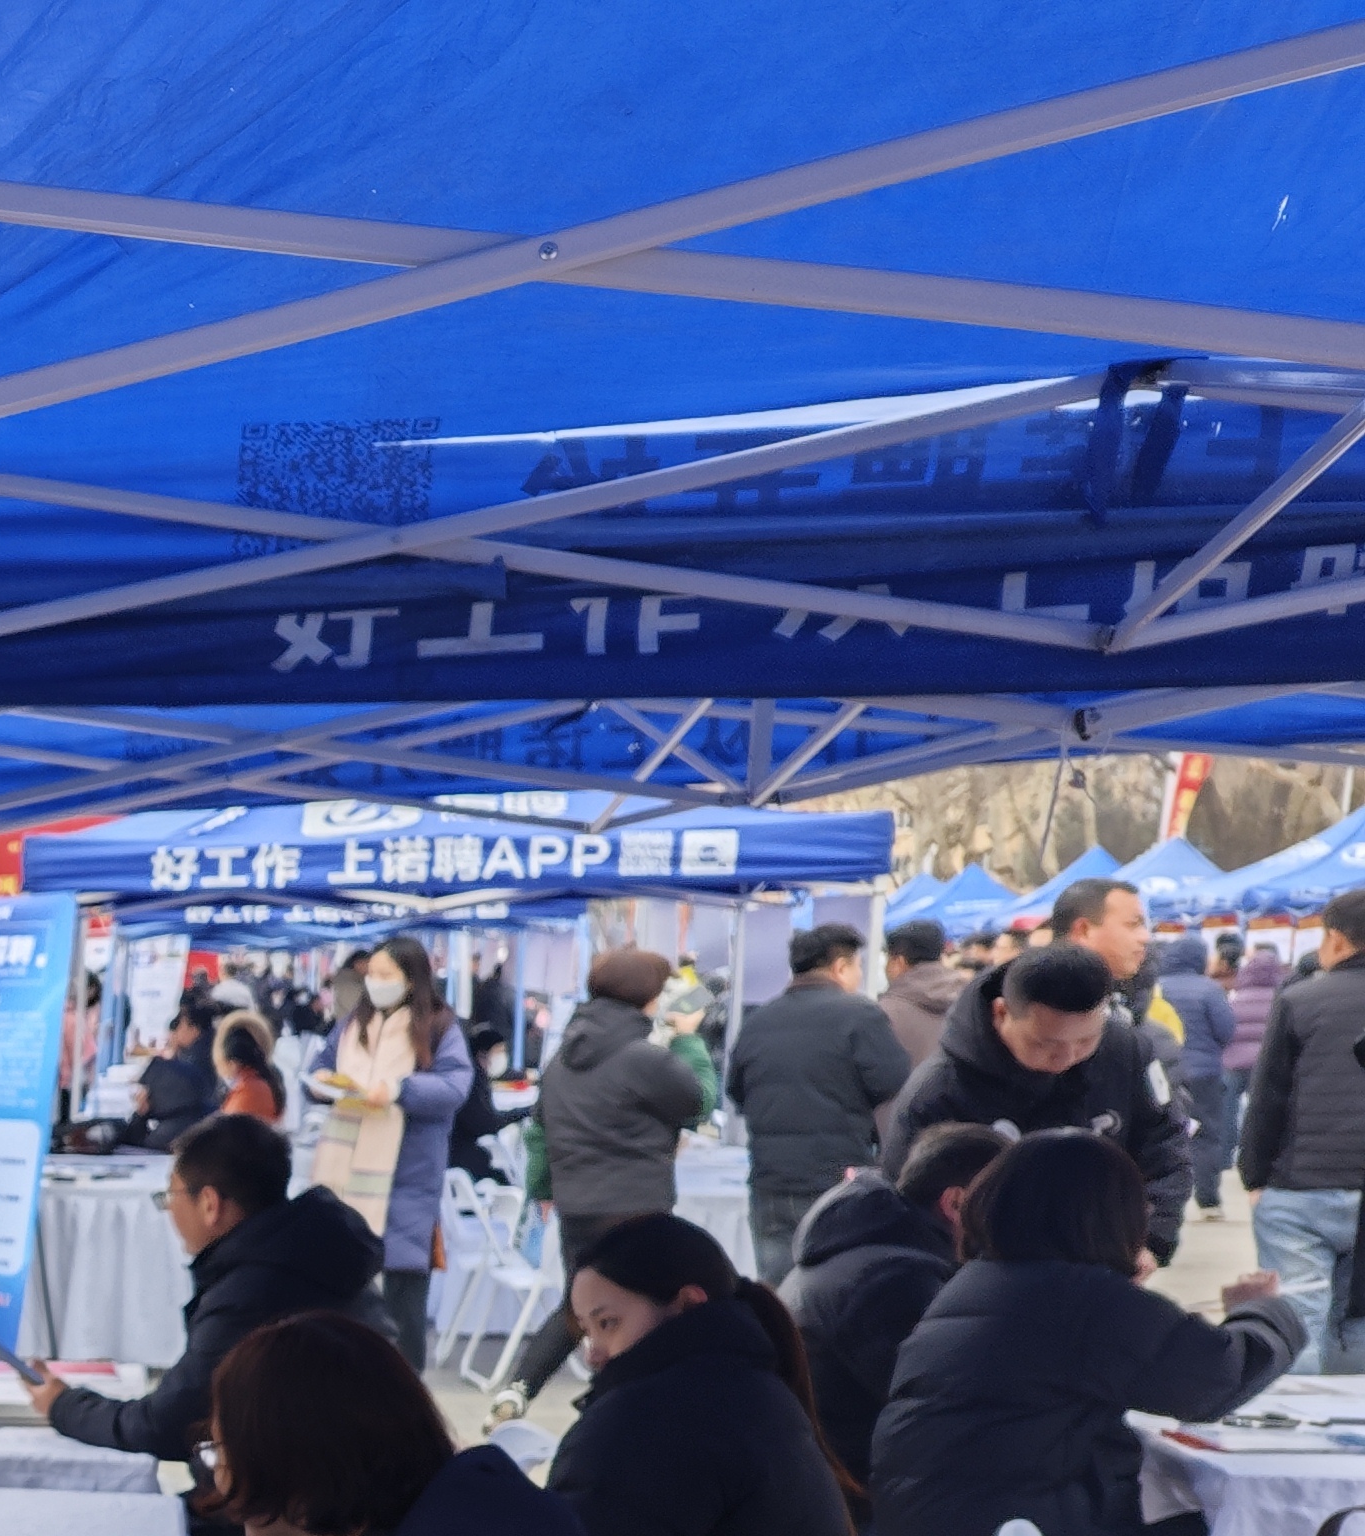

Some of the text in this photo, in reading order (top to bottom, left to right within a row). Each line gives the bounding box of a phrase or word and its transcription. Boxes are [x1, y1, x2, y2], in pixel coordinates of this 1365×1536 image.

[150, 833, 612, 891] 好工作 上诺聘APP
